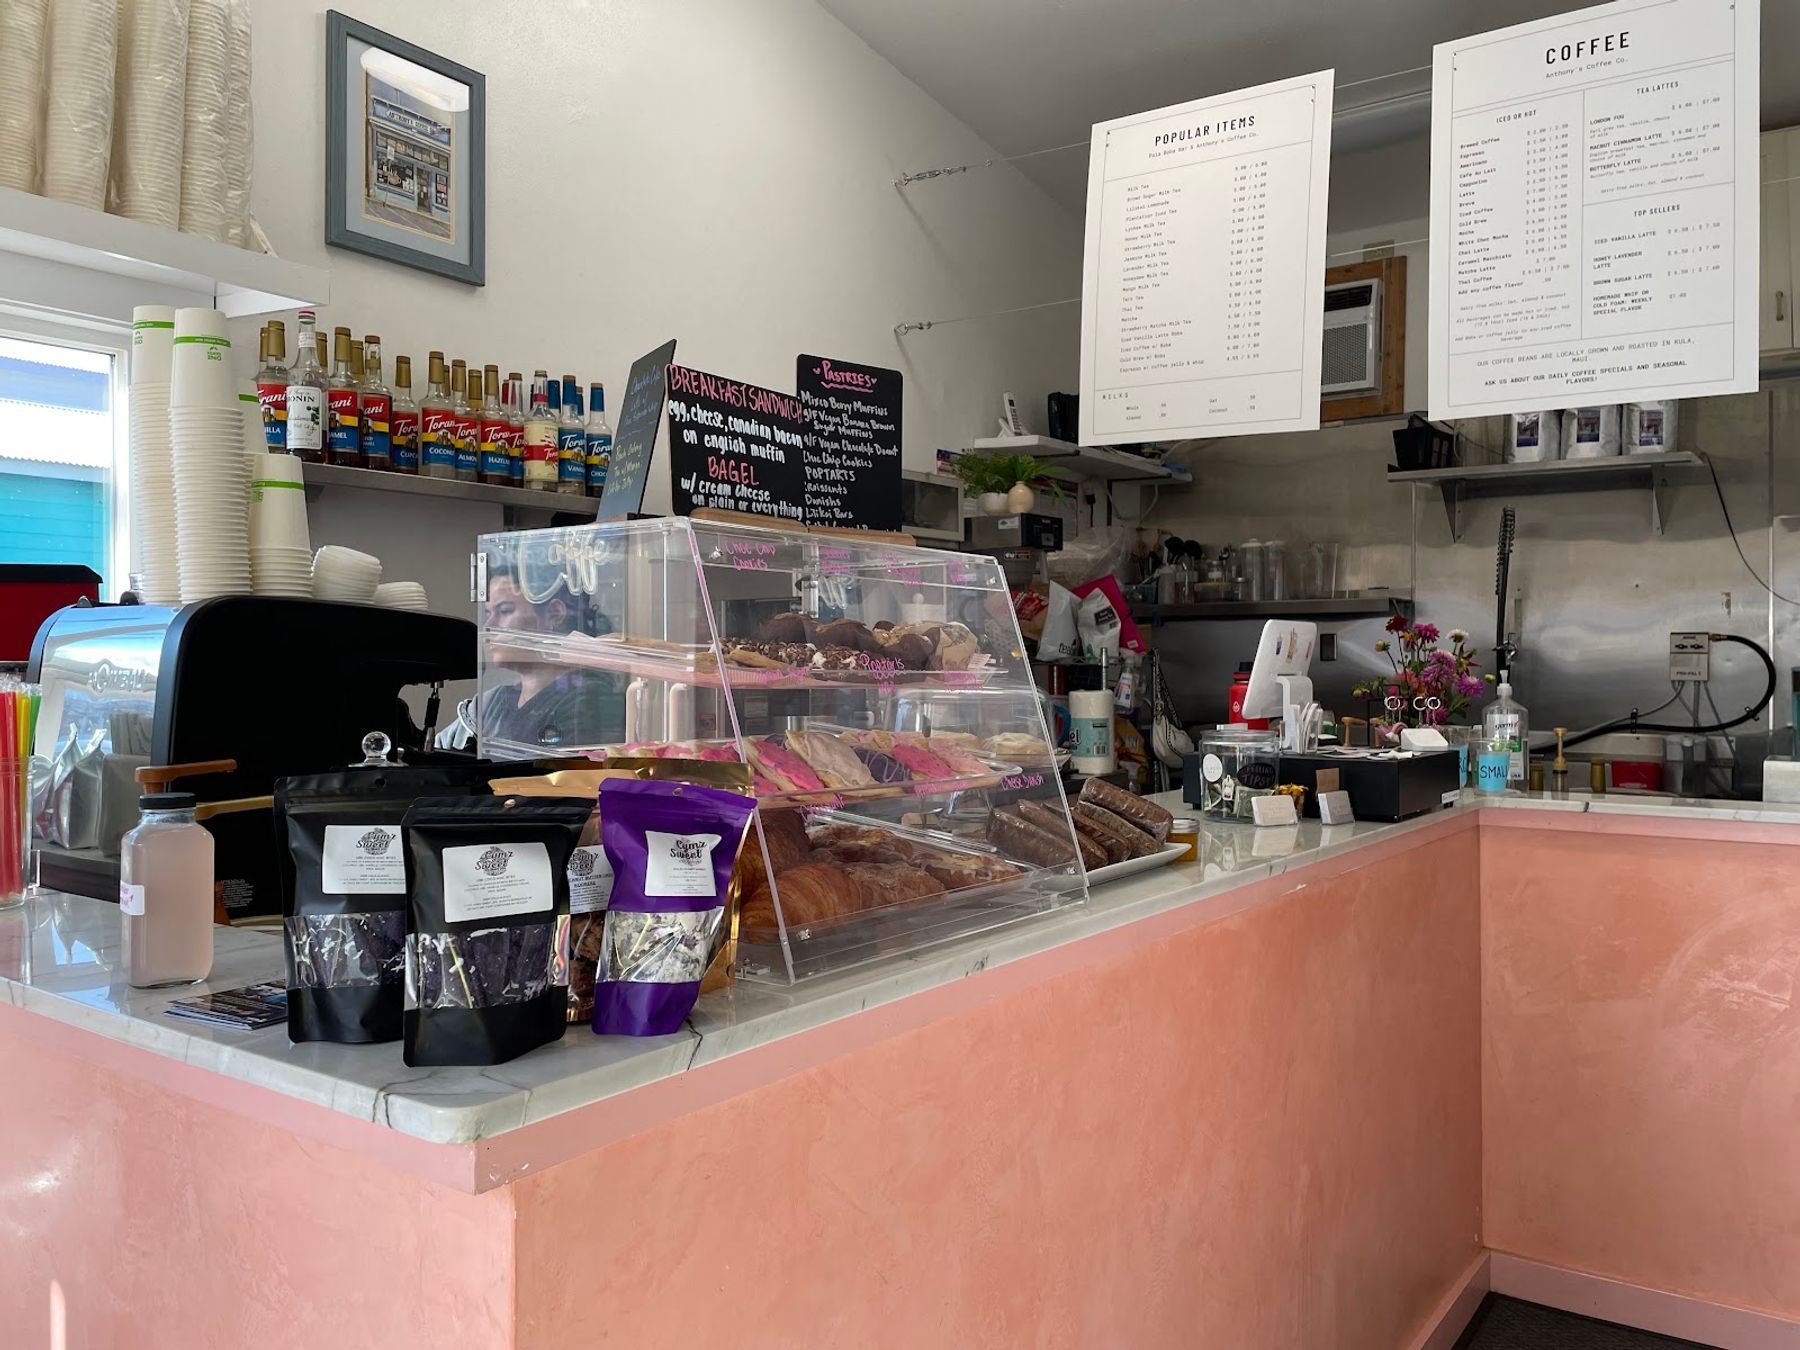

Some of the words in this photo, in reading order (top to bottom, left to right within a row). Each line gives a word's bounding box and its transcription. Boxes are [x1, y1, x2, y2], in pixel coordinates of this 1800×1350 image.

[1545, 30, 1629, 65] COFFEE
[1545, 65, 1582, 79] Anthony's
[1586, 58, 1611, 70] Coffee
[1636, 86, 1649, 94] TEA
[1652, 80, 1678, 92] LATTES
[1496, 114, 1510, 123] ICED
[1524, 108, 1536, 117] HOT
[1154, 124, 1210, 146] POPULAR
[1216, 114, 1255, 133] ITEMS
[1633, 208, 1646, 217] TOP
[1650, 203, 1680, 215] SELLERS
[669, 364, 747, 408] BREAKFAST
[748, 387, 803, 424] SANDWICH
[728, 416, 772, 441] canadian
[773, 426, 804, 449] bacon
[870, 420, 896, 431] Brown
[682, 428, 698, 445] on
[704, 433, 746, 455] english
[750, 442, 786, 464] muffin
[707, 456, 760, 486] BAGEL
[842, 454, 873, 468] Cookies
[804, 466, 856, 482] POPTARTS
[680, 472, 697, 493] w/
[698, 480, 732, 497] cream
[735, 484, 771, 501] cheese
[692, 494, 705, 506] on
[708, 495, 735, 510] plain
[738, 500, 749, 512] or
[752, 500, 804, 521] everything
[833, 508, 854, 519] Bars
